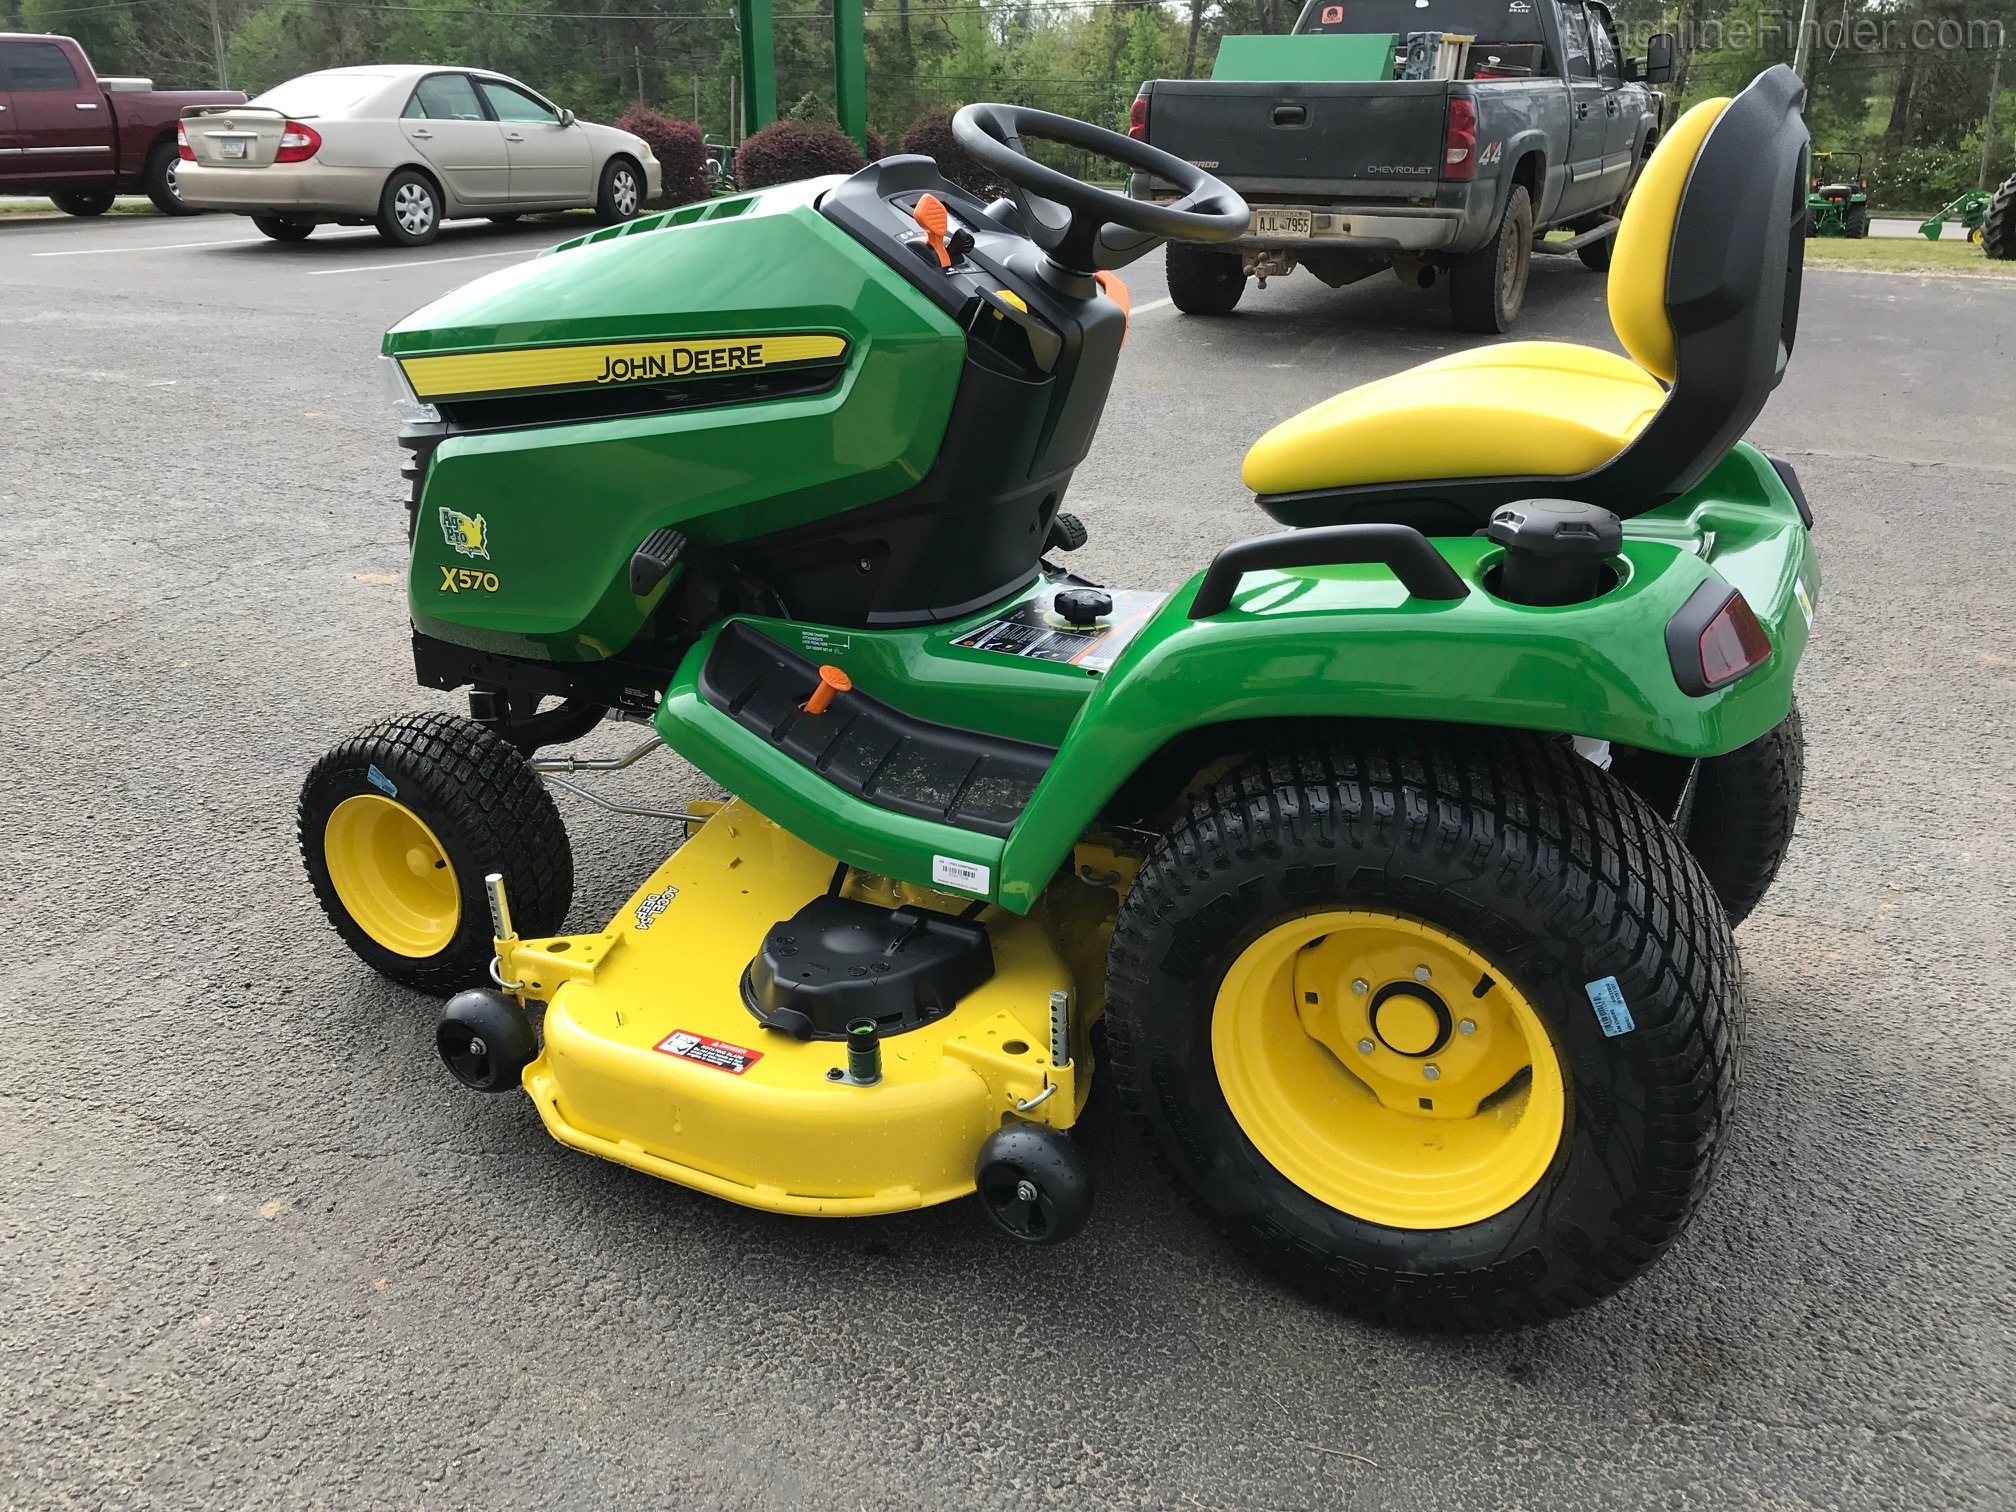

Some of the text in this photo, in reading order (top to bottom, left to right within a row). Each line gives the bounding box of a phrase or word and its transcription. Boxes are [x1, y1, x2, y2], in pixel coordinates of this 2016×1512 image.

[1188, 161, 1220, 169] RADO
[1367, 165, 1433, 175] CHEVROLET
[596, 344, 765, 382] JOHN DEERE
[440, 565, 500, 594] X570
[648, 885, 679, 916] ACCEL
